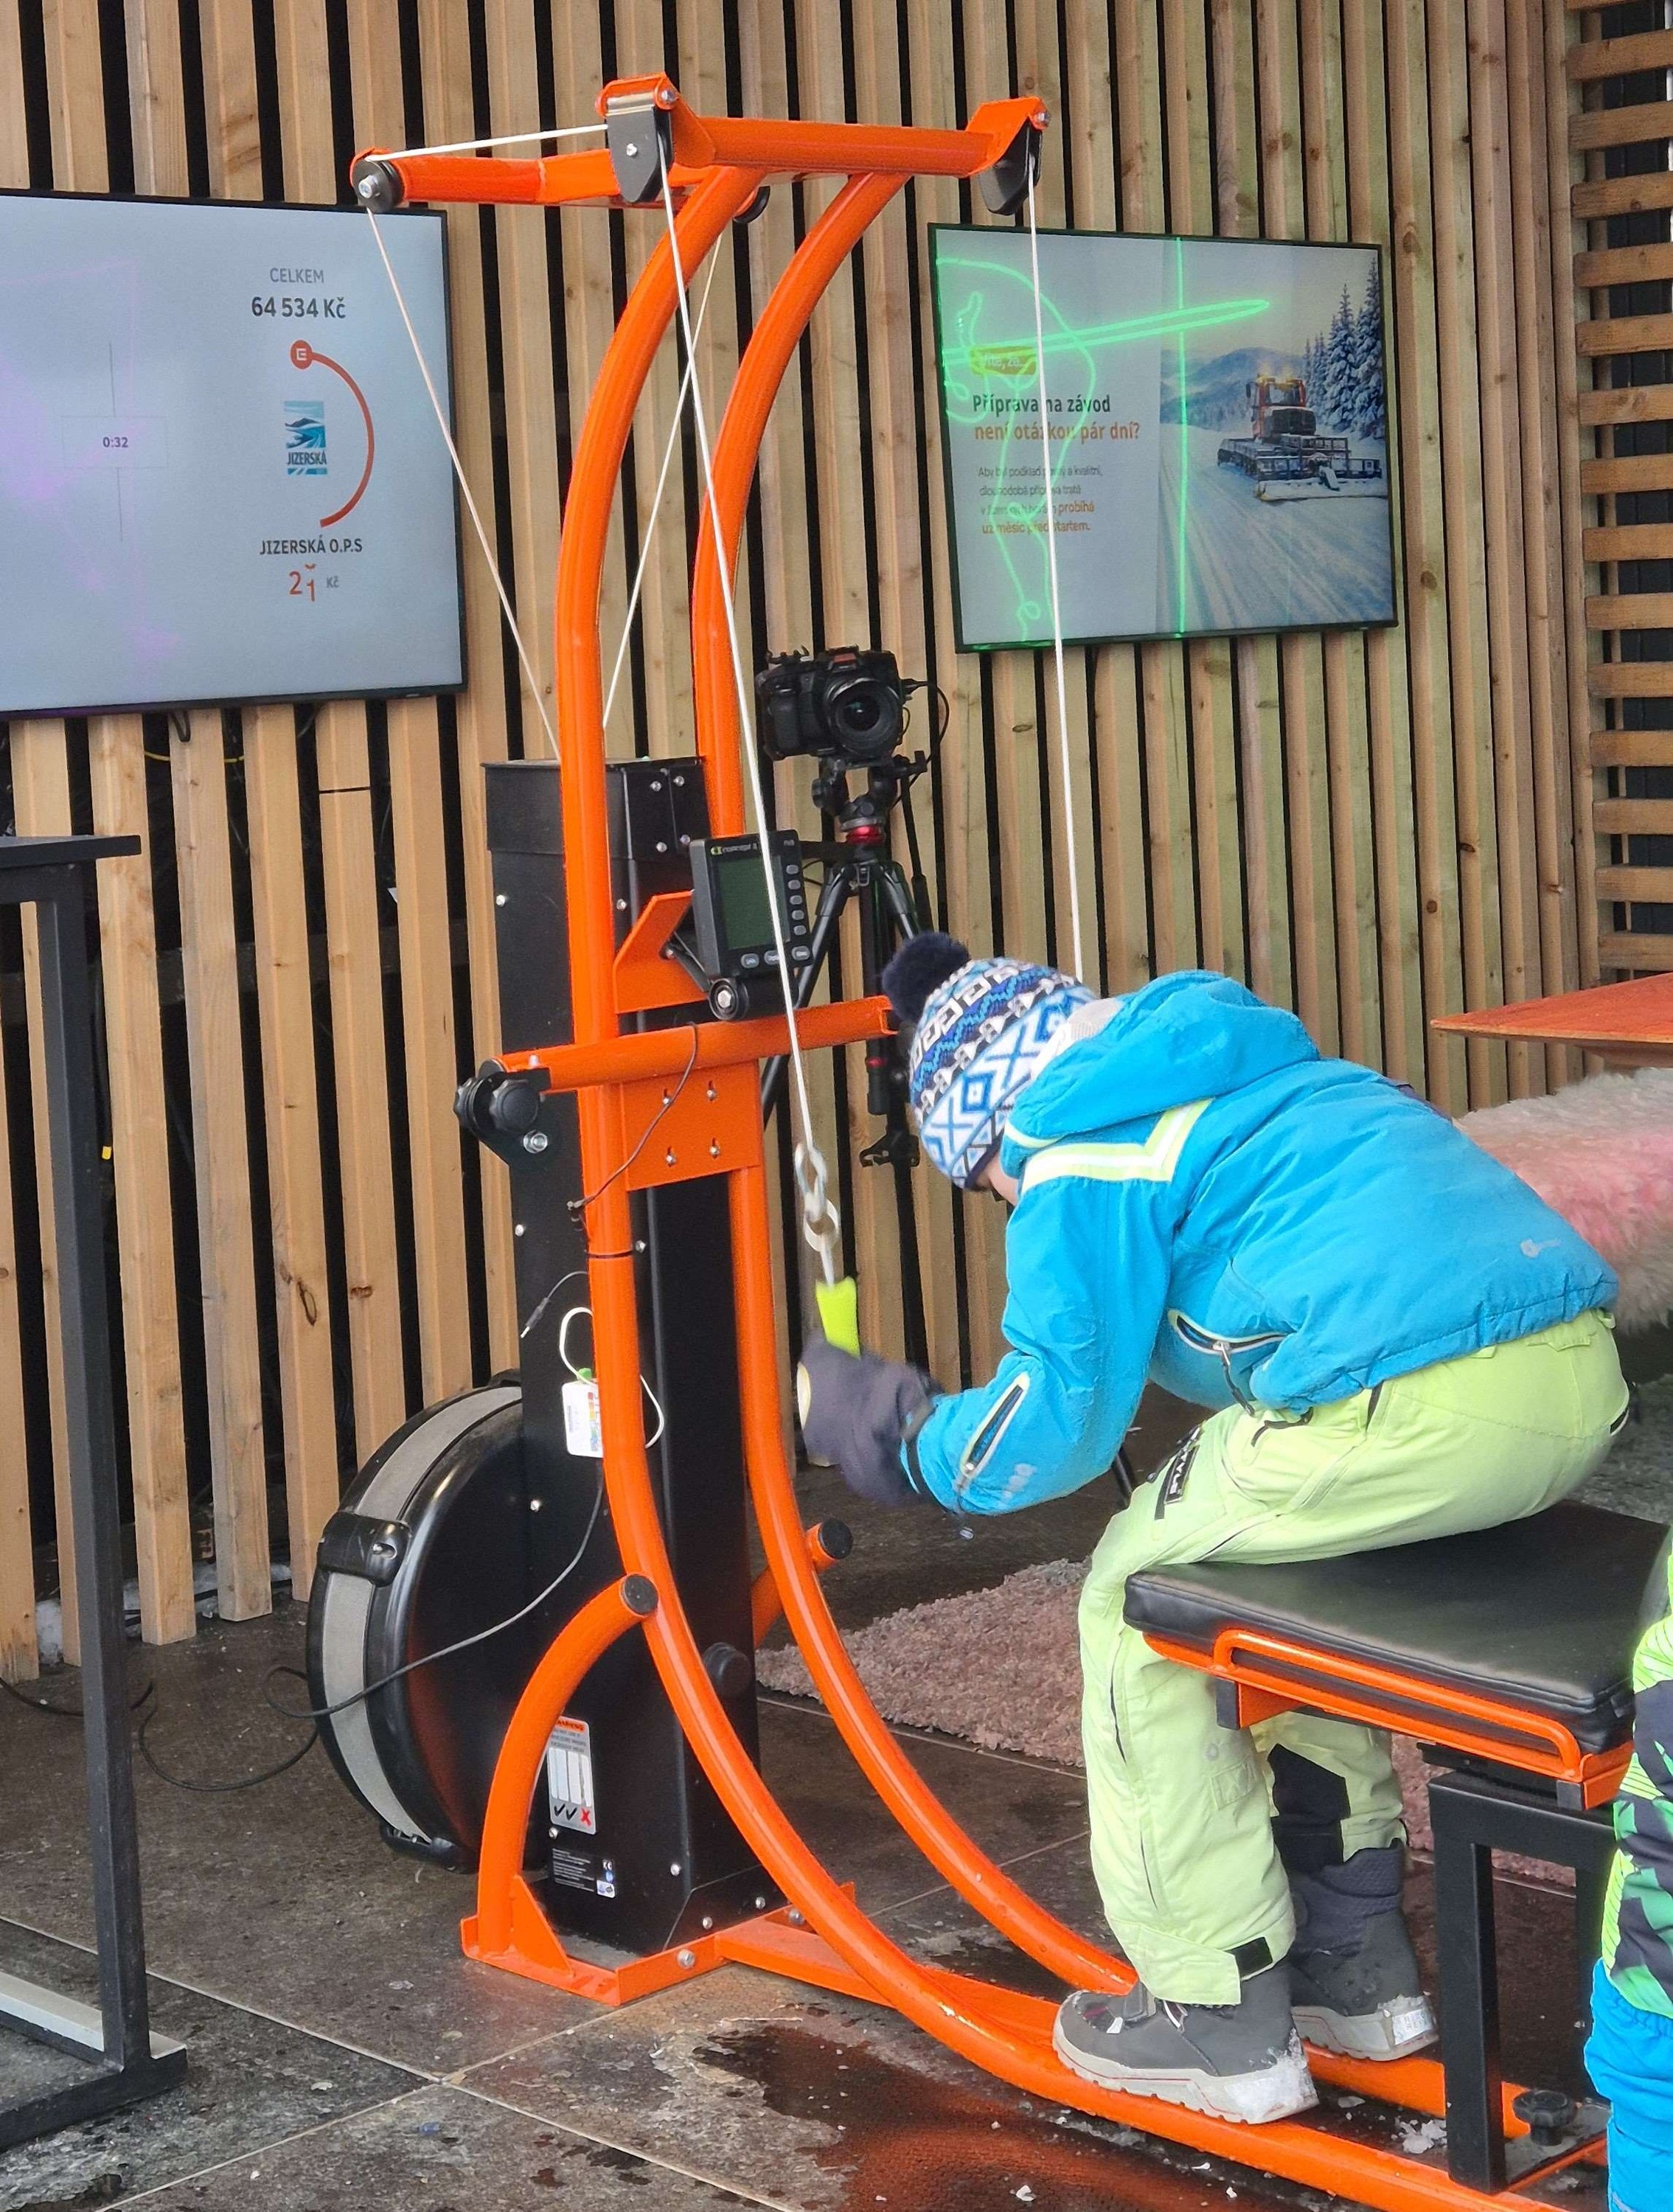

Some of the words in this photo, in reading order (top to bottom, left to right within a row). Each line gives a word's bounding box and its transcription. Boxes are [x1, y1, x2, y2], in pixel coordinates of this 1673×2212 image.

[270, 268, 324, 283] CELKEM
[323, 296, 347, 319] Kč
[973, 394, 1039, 417] Příprava
[1044, 398, 1062, 413] na
[1067, 394, 1110, 413] závod
[975, 421, 1009, 440] není
[1081, 421, 1105, 444] pár
[1110, 421, 1141, 439] dní?
[102, 437, 128, 448] 0:32
[1058, 500, 1095, 516] probíhá
[260, 535, 326, 555] JIZERSKÁ
[330, 538, 363, 553] O.P.S
[326, 576, 340, 588] Kč
